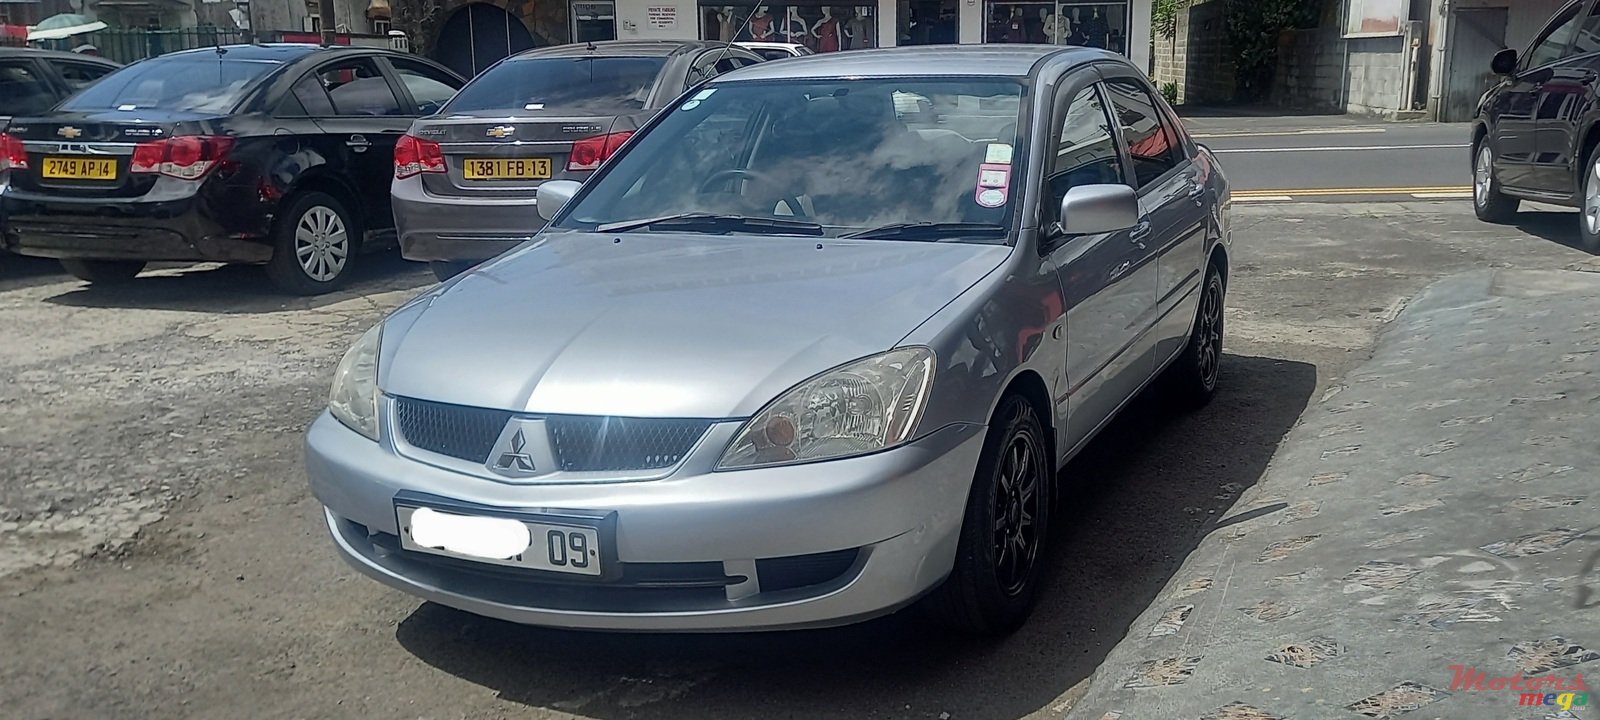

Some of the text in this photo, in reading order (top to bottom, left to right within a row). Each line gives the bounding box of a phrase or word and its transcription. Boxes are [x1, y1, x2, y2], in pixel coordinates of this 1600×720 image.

[49, 160, 76, 175] 2749
[81, 161, 95, 176] AP
[470, 161, 501, 176] 1381
[507, 161, 525, 176] FB
[547, 530, 589, 568] 09
